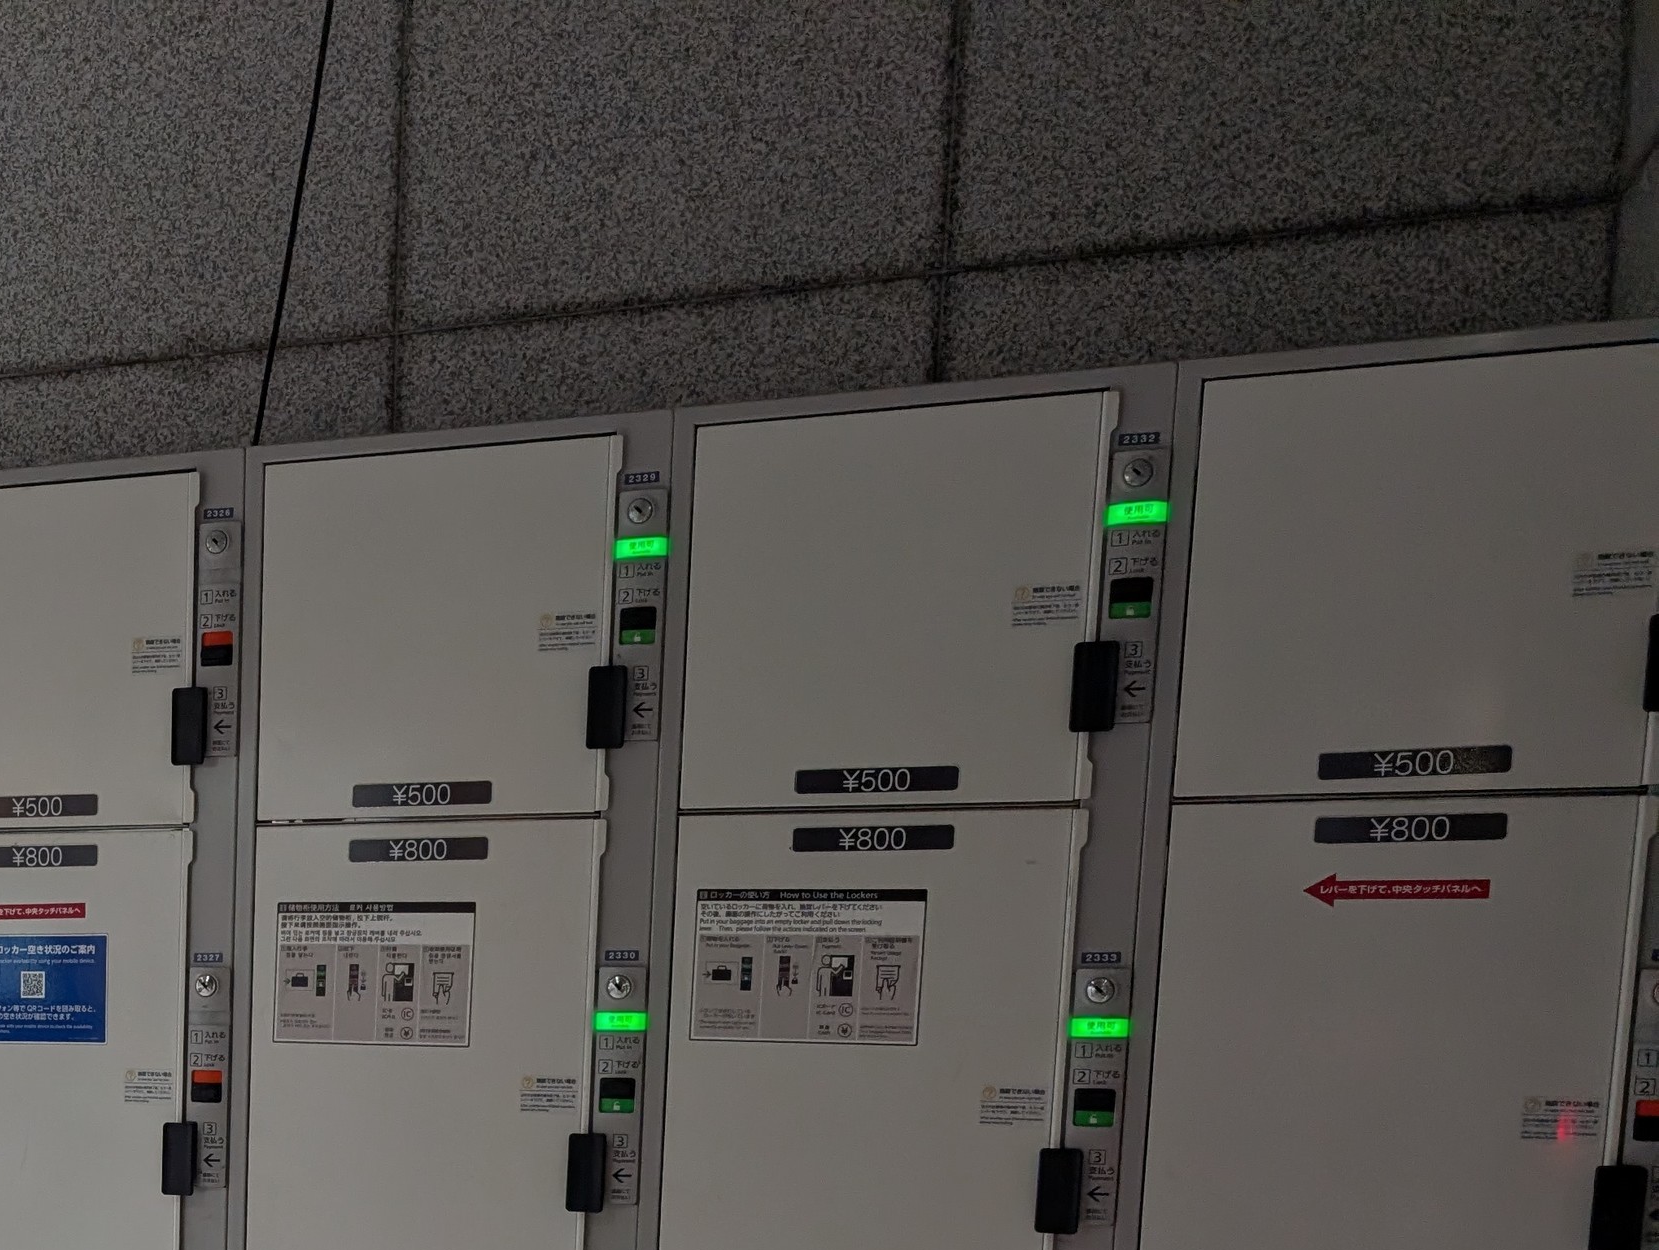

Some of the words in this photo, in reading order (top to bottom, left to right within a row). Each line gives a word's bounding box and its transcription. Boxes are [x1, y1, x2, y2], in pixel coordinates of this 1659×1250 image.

[1122, 433, 1156, 445] 2332
[628, 472, 656, 483] 2329
[1124, 503, 1153, 515] 使用可
[1133, 528, 1160, 539] 入れる
[629, 540, 655, 550] 使用可
[637, 562, 661, 572] 入れる
[1130, 557, 1160, 567] 下げる
[214, 590, 237, 599] 入れる
[637, 588, 661, 597] 下げる
[214, 614, 236, 623] 下げる
[1124, 659, 1152, 669] 支払う
[635, 681, 658, 691] 支払う
[213, 701, 235, 710] 支払う
[1374, 750, 1454, 776] ¥500
[843, 769, 910, 792] ¥500
[393, 784, 450, 805] ¥500
[12, 797, 62, 816] ¥500
[1370, 816, 1449, 841] ¥800
[839, 828, 906, 850] ¥800
[390, 840, 446, 860] ¥800
[13, 847, 62, 866] ¥800
[1319, 883, 1482, 896] レバーを下げて、中央タッチパネルへ
[710, 891, 770, 899] ロッカーの使い方
[780, 891, 799, 899] How
[846, 891, 878, 899] Lockers
[196, 953, 220, 962] 2327
[608, 951, 636, 960] 2330
[1085, 953, 1117, 962] 2333
[608, 1015, 633, 1024] 使用可
[1087, 1021, 1116, 1030] 使用可
[616, 1036, 640, 1045] 入れる
[1095, 1044, 1122, 1052] 入れる
[615, 1060, 639, 1069] 下げる
[1093, 1069, 1120, 1079] 下げる
[612, 1149, 637, 1158] 支払う
[1088, 1167, 1115, 1175] 支払う
